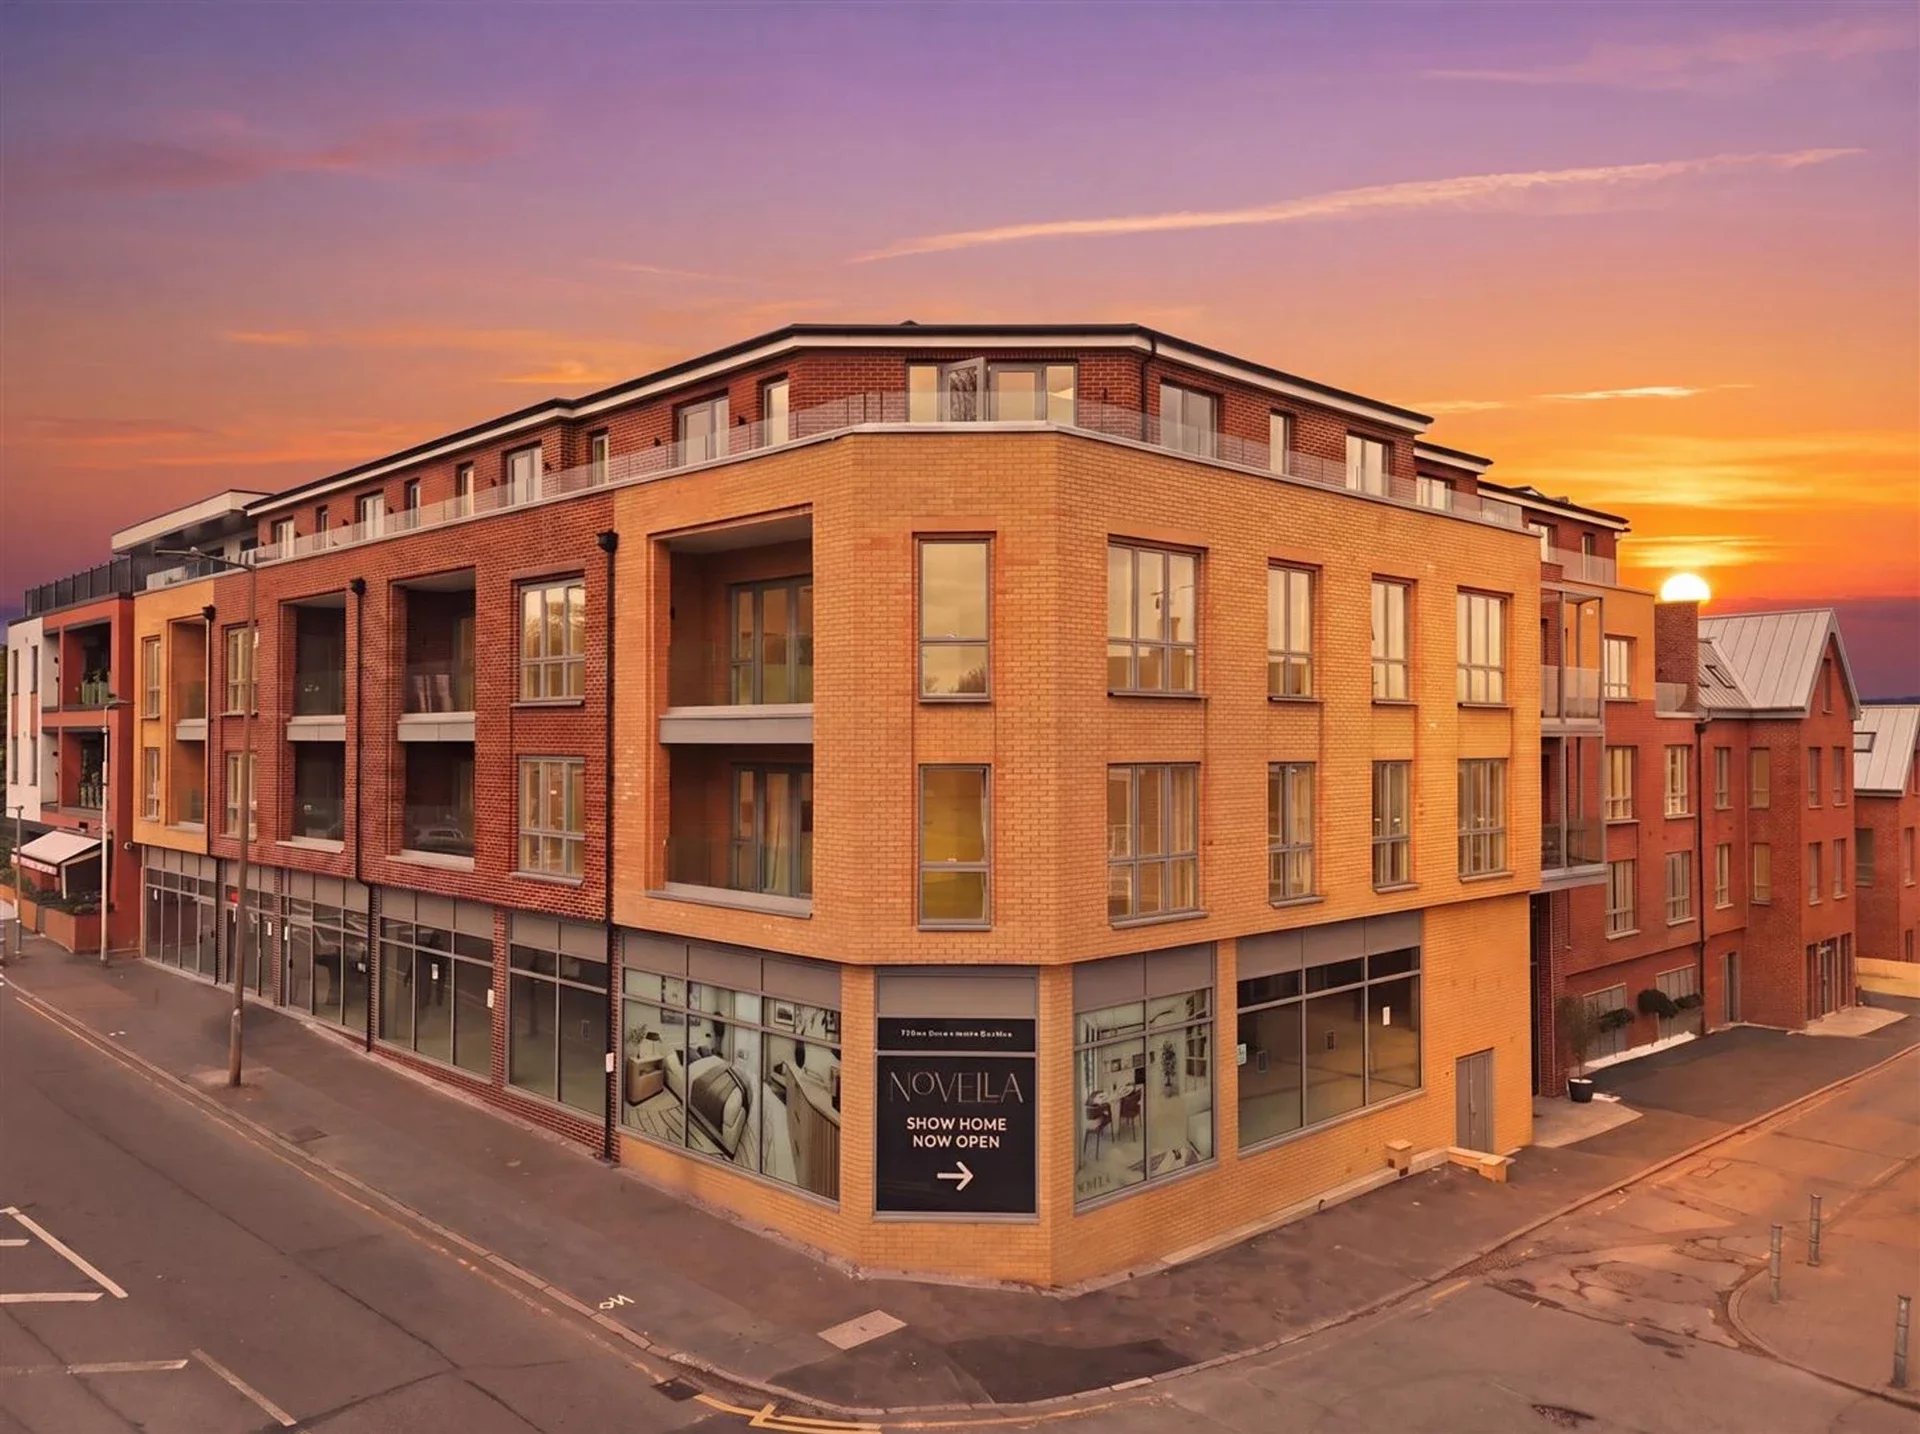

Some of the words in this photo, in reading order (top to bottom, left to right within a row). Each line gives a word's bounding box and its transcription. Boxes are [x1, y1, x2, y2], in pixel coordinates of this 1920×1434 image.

[890, 1072, 1023, 1103] NOVELLA
[906, 1117, 955, 1130] SHOW
[959, 1117, 1007, 1131] HOME
[913, 1135, 952, 1147] NOW
[956, 1135, 1000, 1148] OPEN
